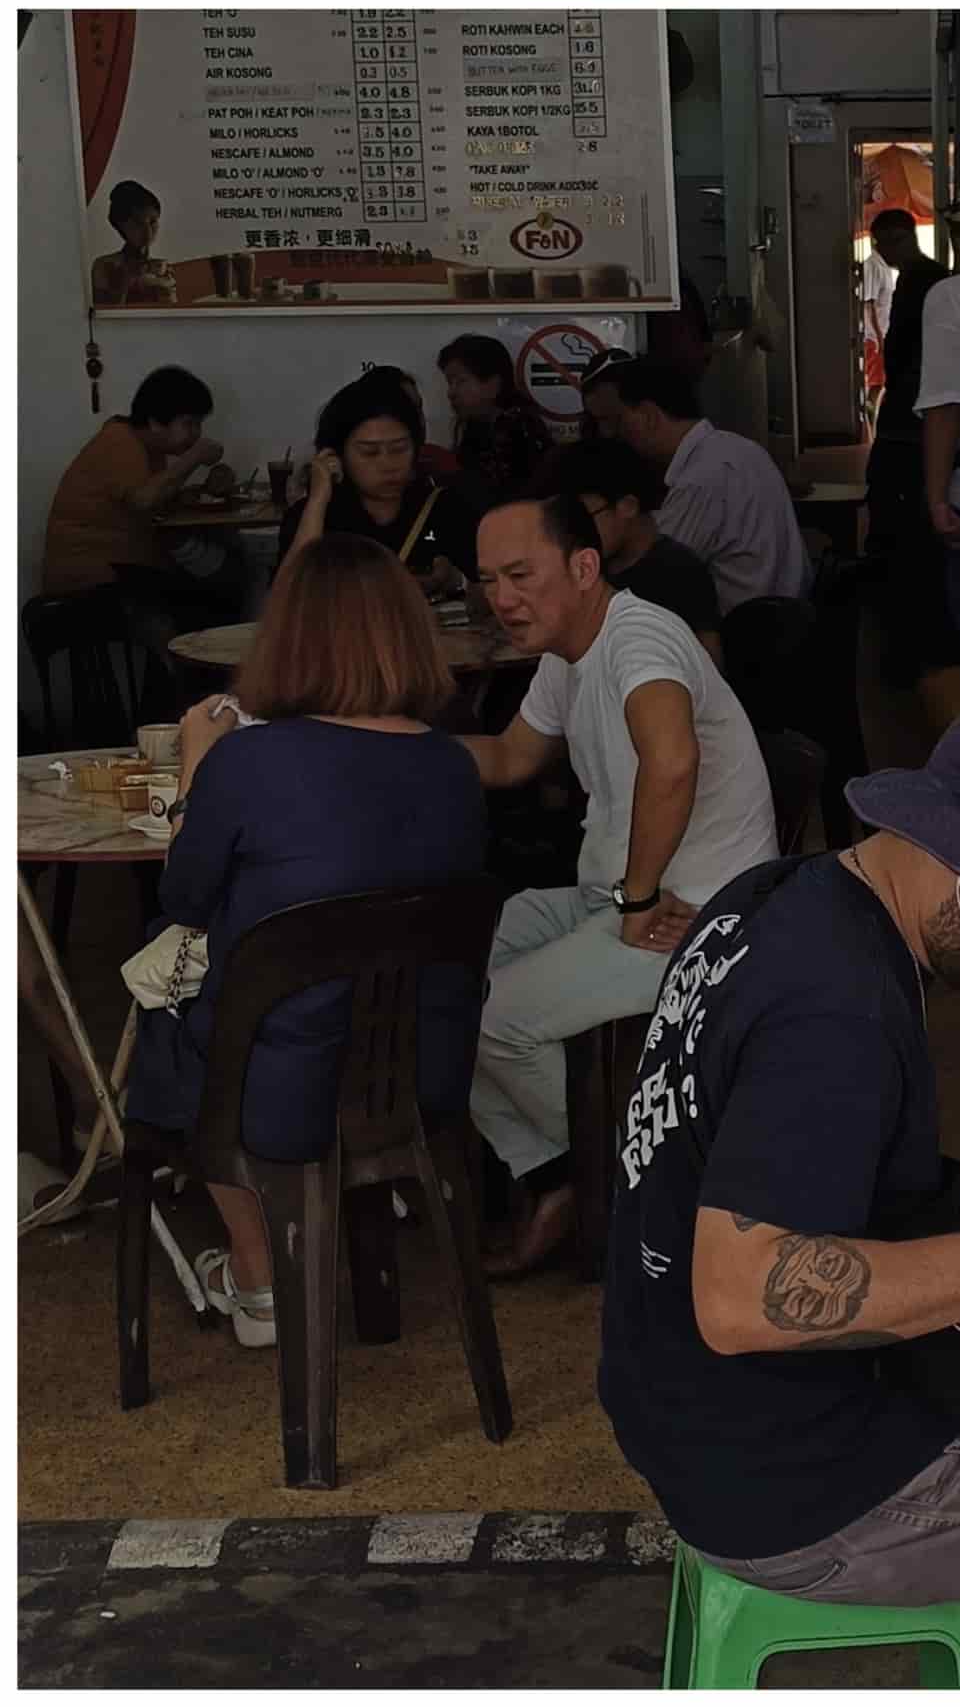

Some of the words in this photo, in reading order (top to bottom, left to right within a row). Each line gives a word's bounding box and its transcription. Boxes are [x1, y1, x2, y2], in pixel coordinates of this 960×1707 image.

[203, 27, 224, 38] TEH
[227, 27, 255, 39] SUSU
[461, 25, 486, 35] ROTI
[489, 24, 532, 35] KAHWIN
[535, 24, 564, 35] EACH
[204, 47, 225, 58] TEH
[227, 47, 253, 58] CINA
[462, 45, 487, 55] ROTI
[490, 45, 536, 55] KOSONG
[205, 68, 223, 78] AIR
[226, 68, 273, 79] KOSONG
[464, 86, 509, 96] SERBUK
[512, 86, 537, 96] KOPI
[540, 86, 561, 96] 1KG
[208, 108, 229, 118] PAT
[230, 108, 253, 118] POH
[261, 107, 289, 118] KEAT
[292, 107, 314, 118] POH
[465, 106, 510, 117] SERBUK
[512, 106, 538, 117] KOPI
[209, 128, 236, 139] MILO
[244, 127, 298, 139] HORLICKS
[467, 126, 494, 136] KAYA
[211, 148, 260, 158] NESCAFE
[269, 147, 314, 158] ALMOND
[212, 167, 238, 178] MILO
[263, 167, 308, 178] ALMOND
[470, 182, 489, 192] HOT
[498, 182, 525, 192] COLD
[527, 182, 557, 192] DRINK
[214, 188, 263, 199] NESCAFE
[288, 187, 342, 198] HORLICKS
[215, 207, 258, 218] HERBAL
[261, 207, 281, 218] TEH
[525, 230, 570, 250] F&N
